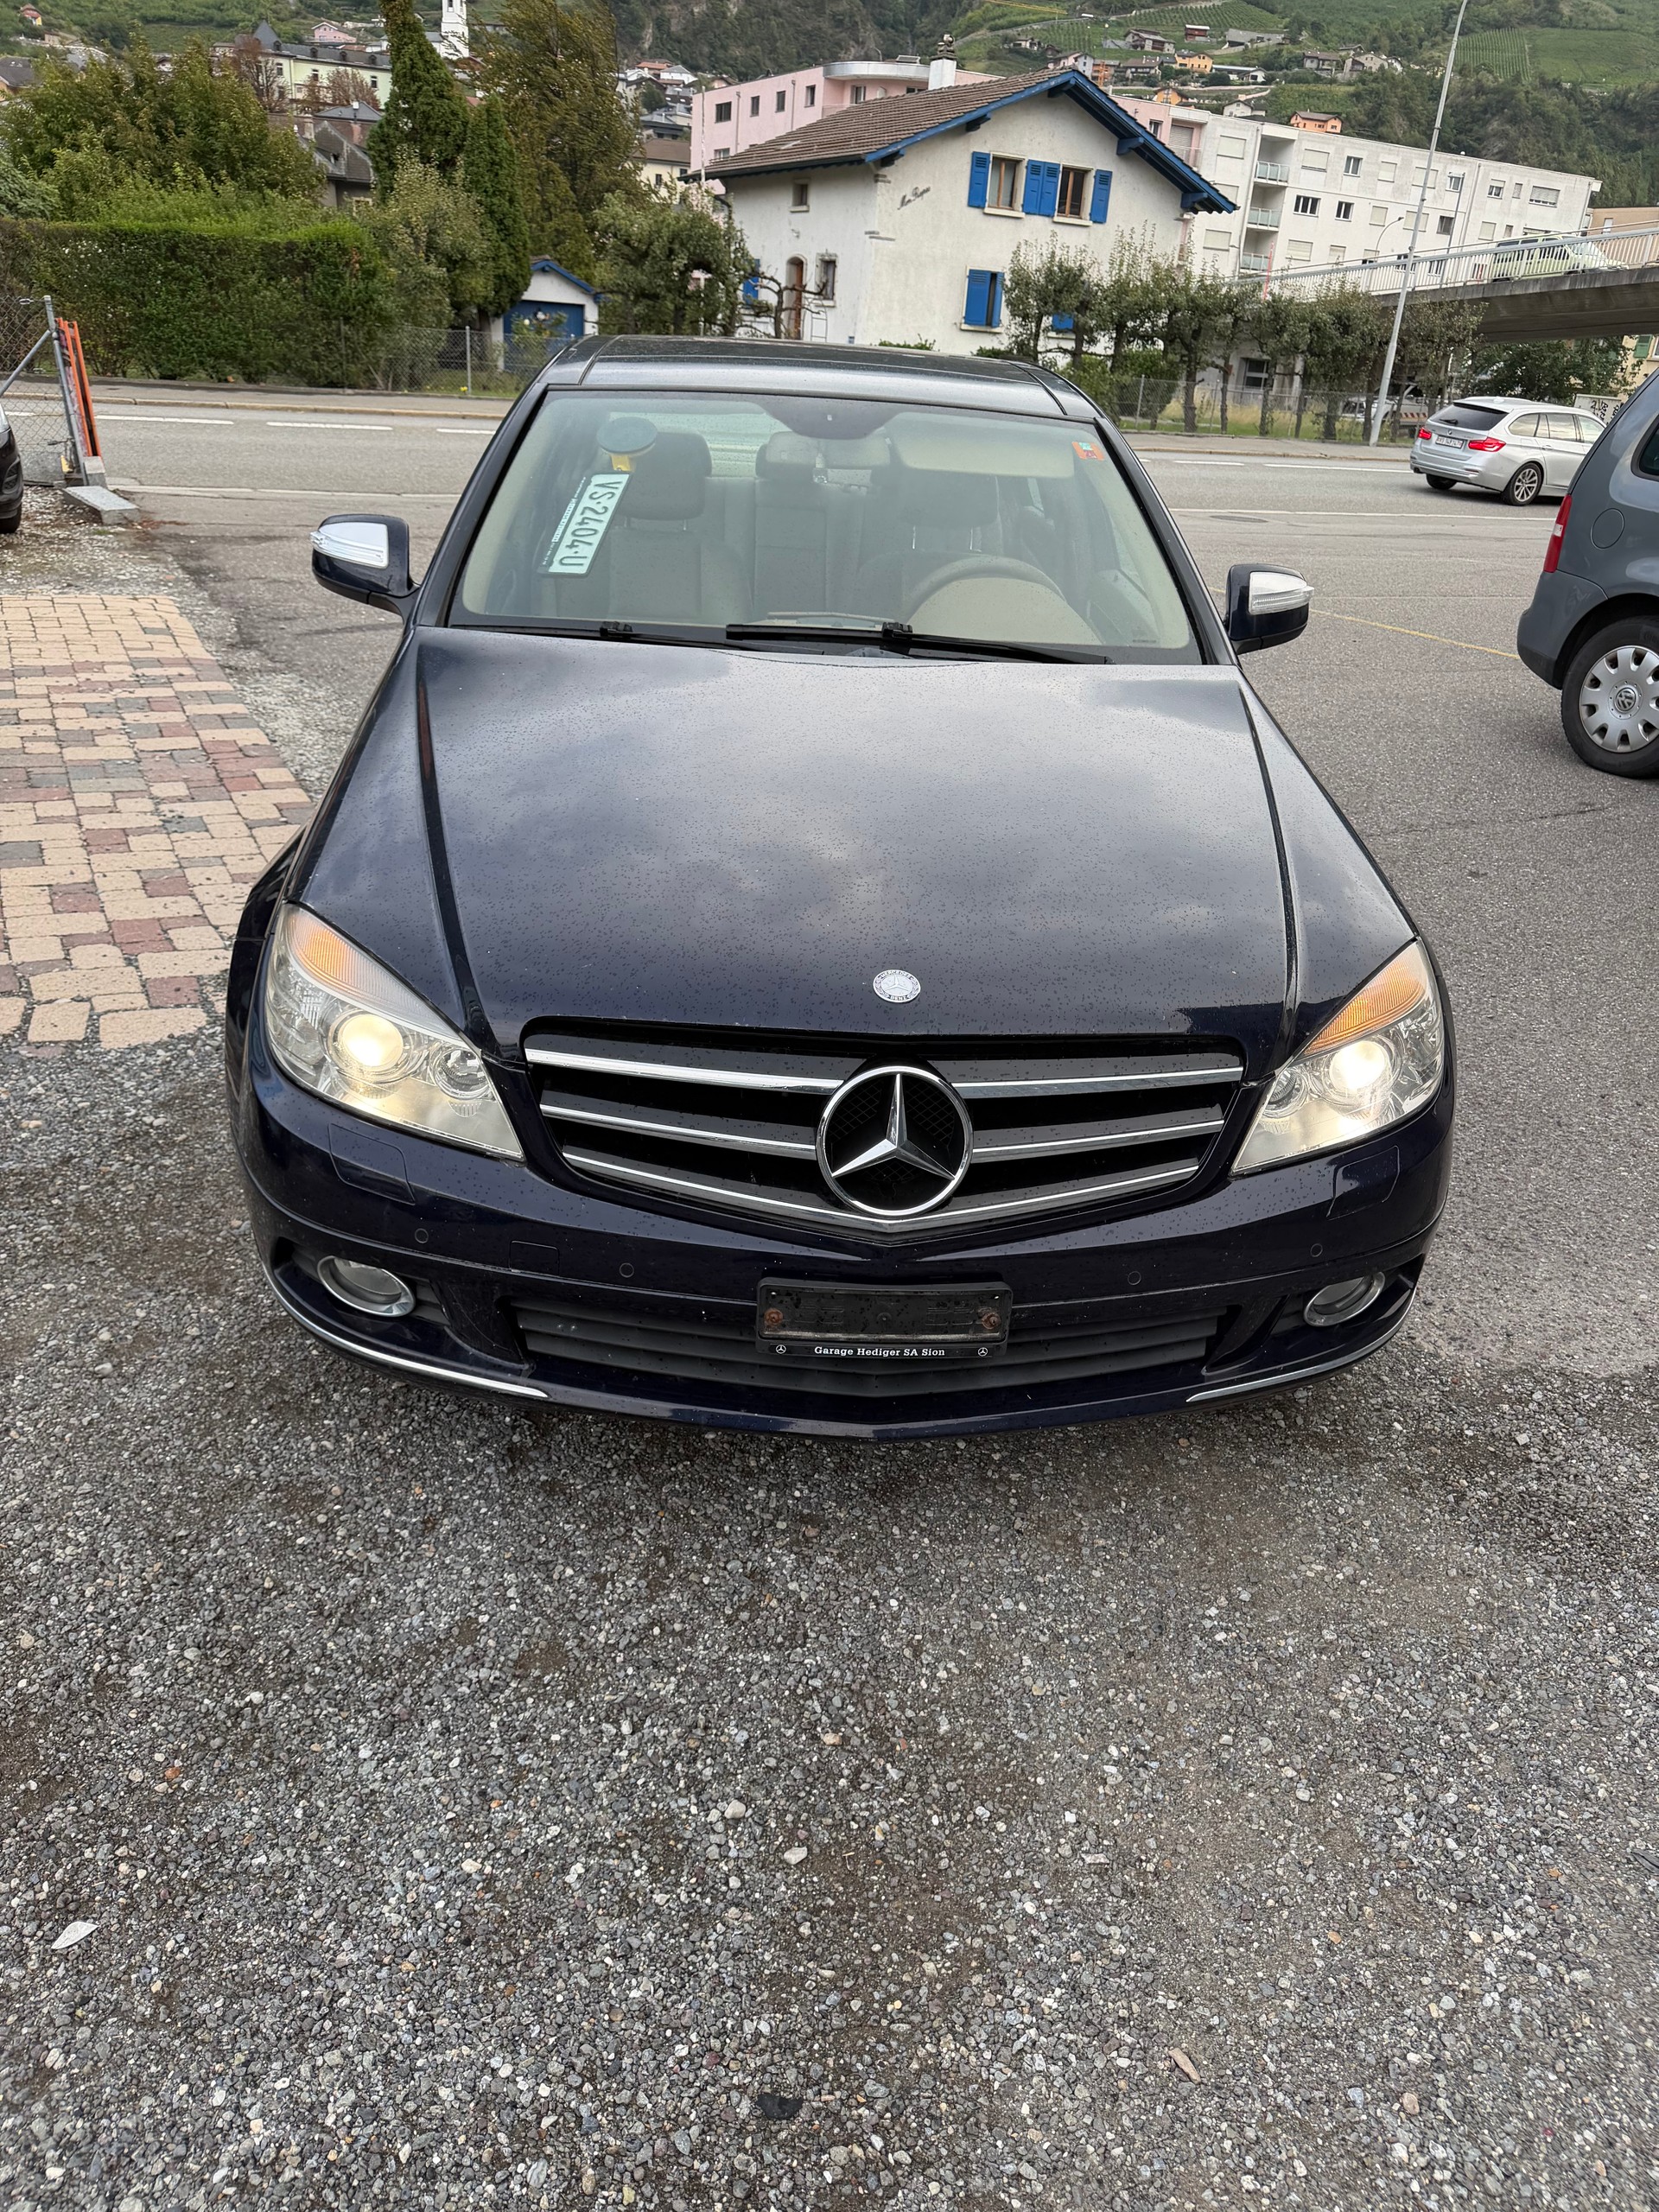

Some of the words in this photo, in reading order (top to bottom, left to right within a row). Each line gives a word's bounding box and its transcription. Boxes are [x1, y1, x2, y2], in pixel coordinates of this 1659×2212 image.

[814, 1346, 854, 1357] Garage
[856, 1348, 901, 1357] Hediger
[903, 1348, 918, 1357] SA
